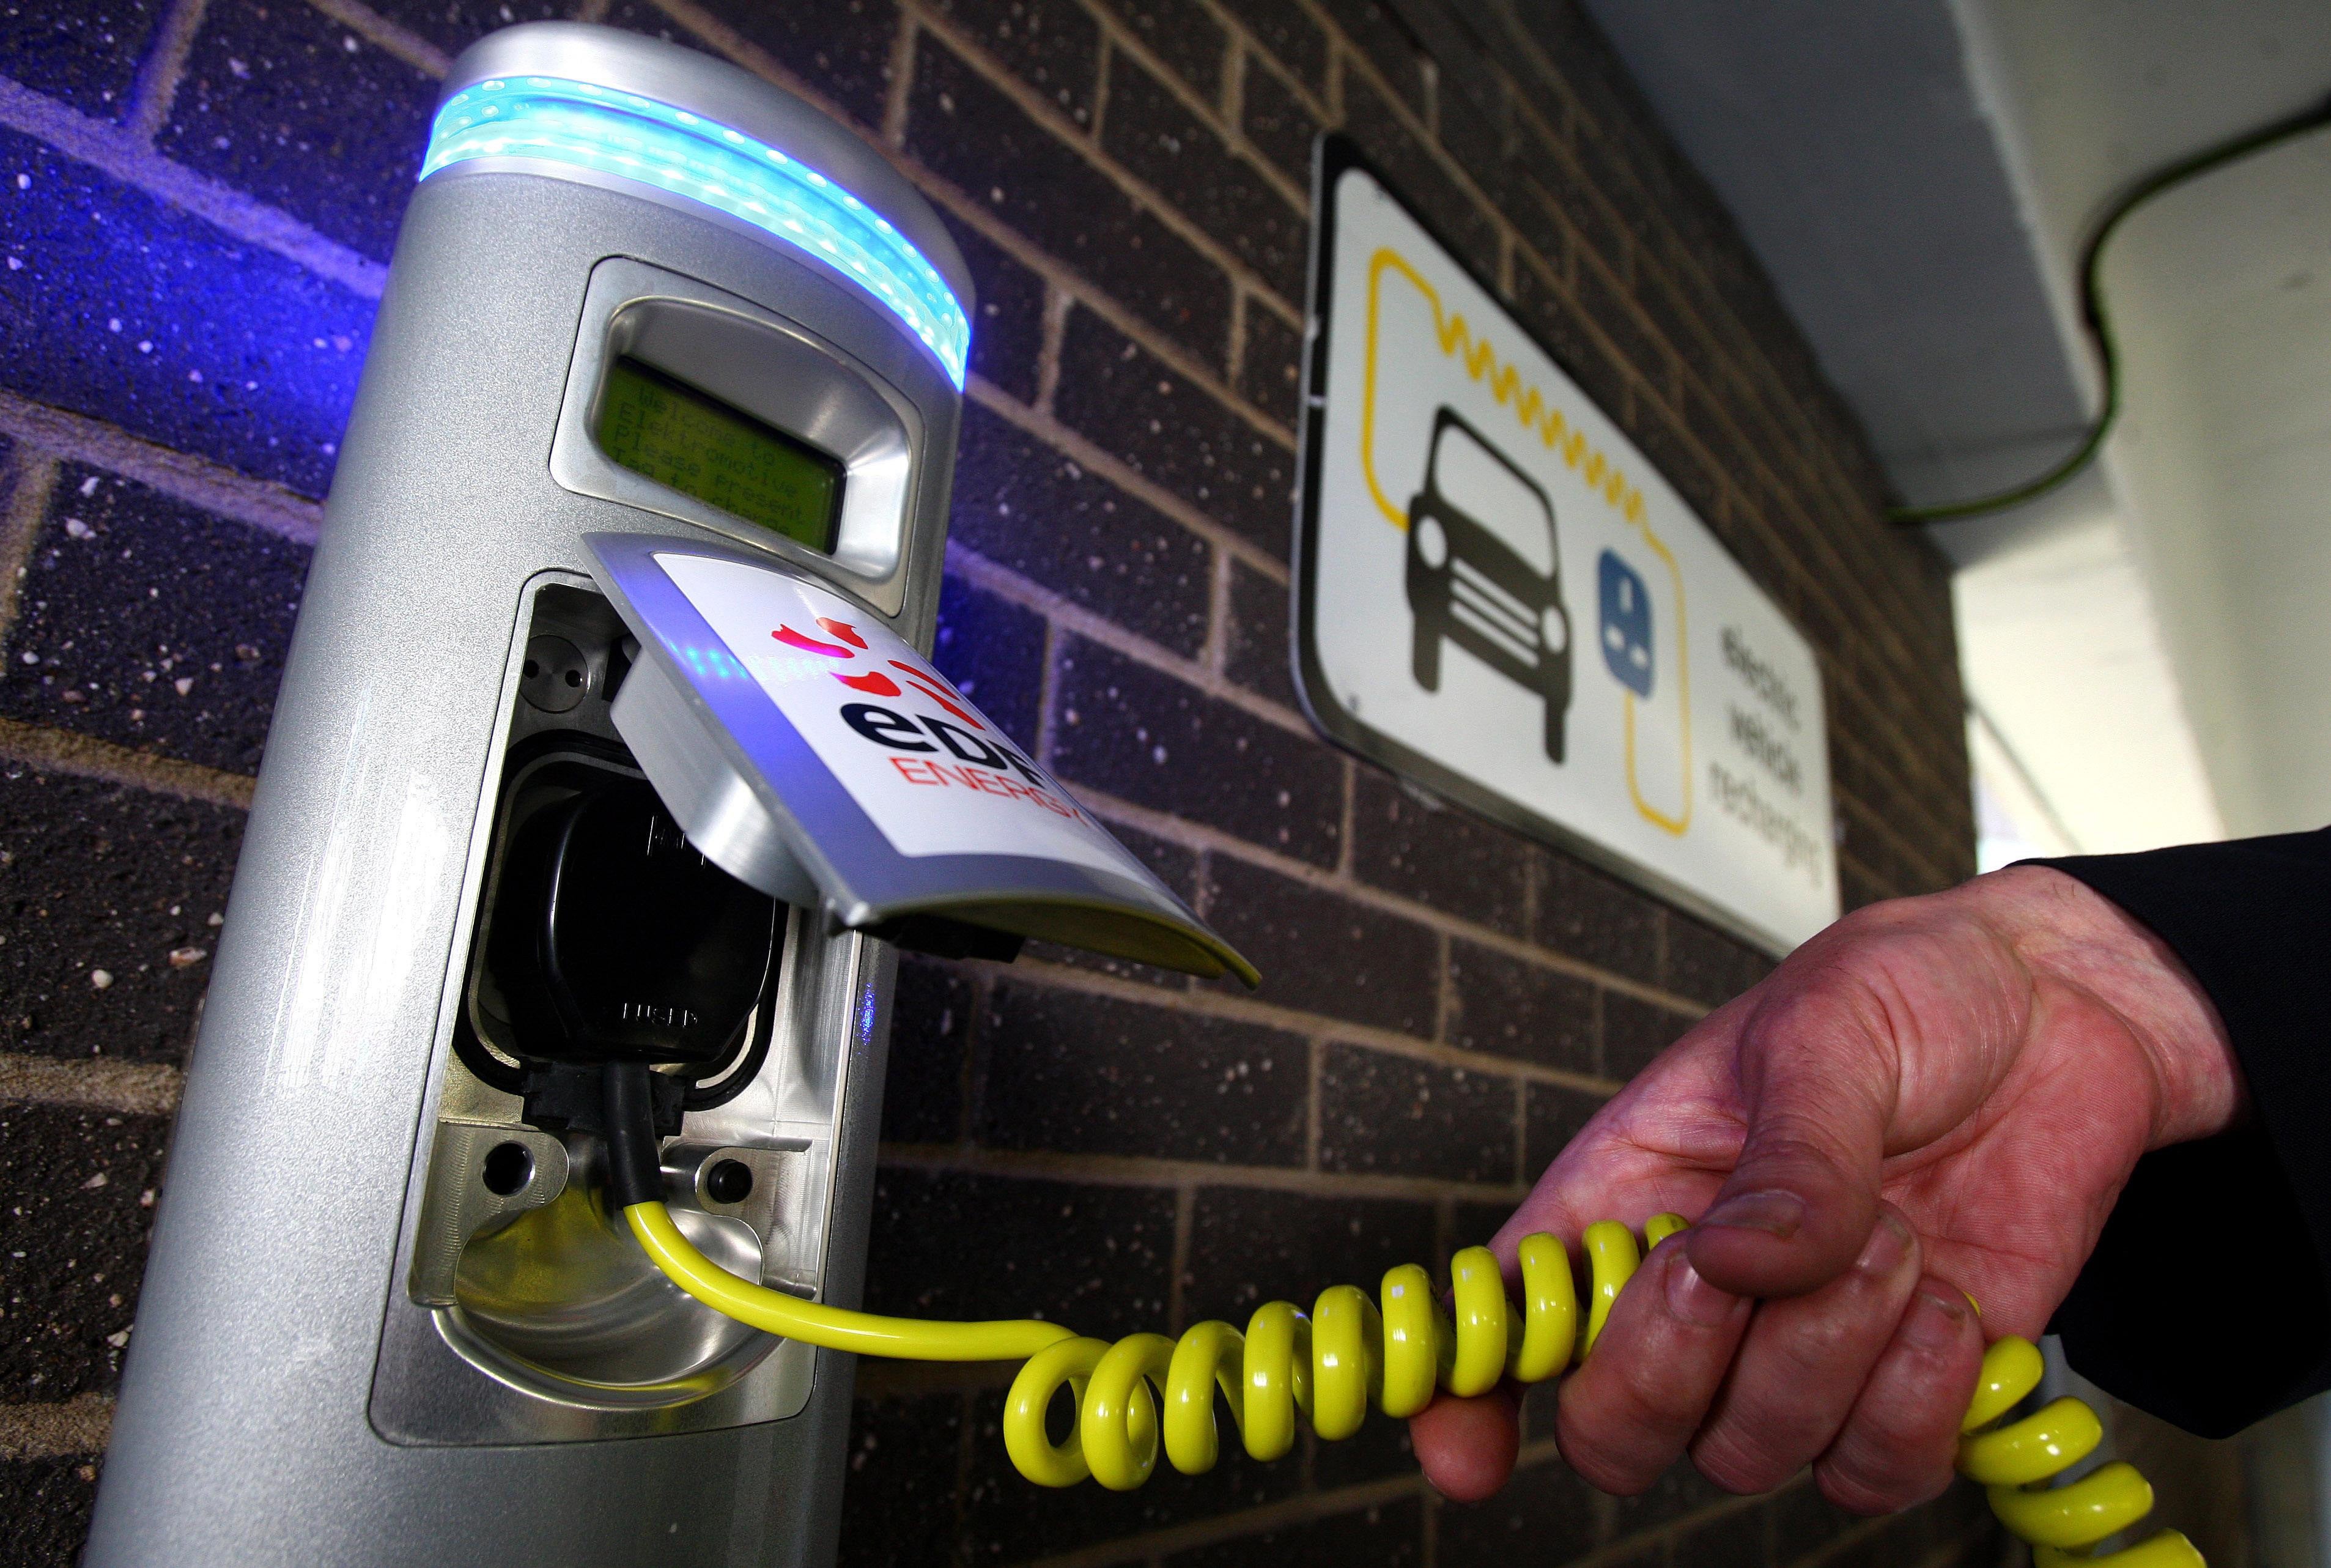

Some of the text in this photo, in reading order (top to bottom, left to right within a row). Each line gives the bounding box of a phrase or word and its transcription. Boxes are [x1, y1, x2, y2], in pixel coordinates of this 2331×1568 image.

[615, 424, 701, 475] Please
[619, 401, 799, 498] Elektromotive
[638, 385, 775, 465] Welcome to
[622, 1002, 698, 1028] FUSED
